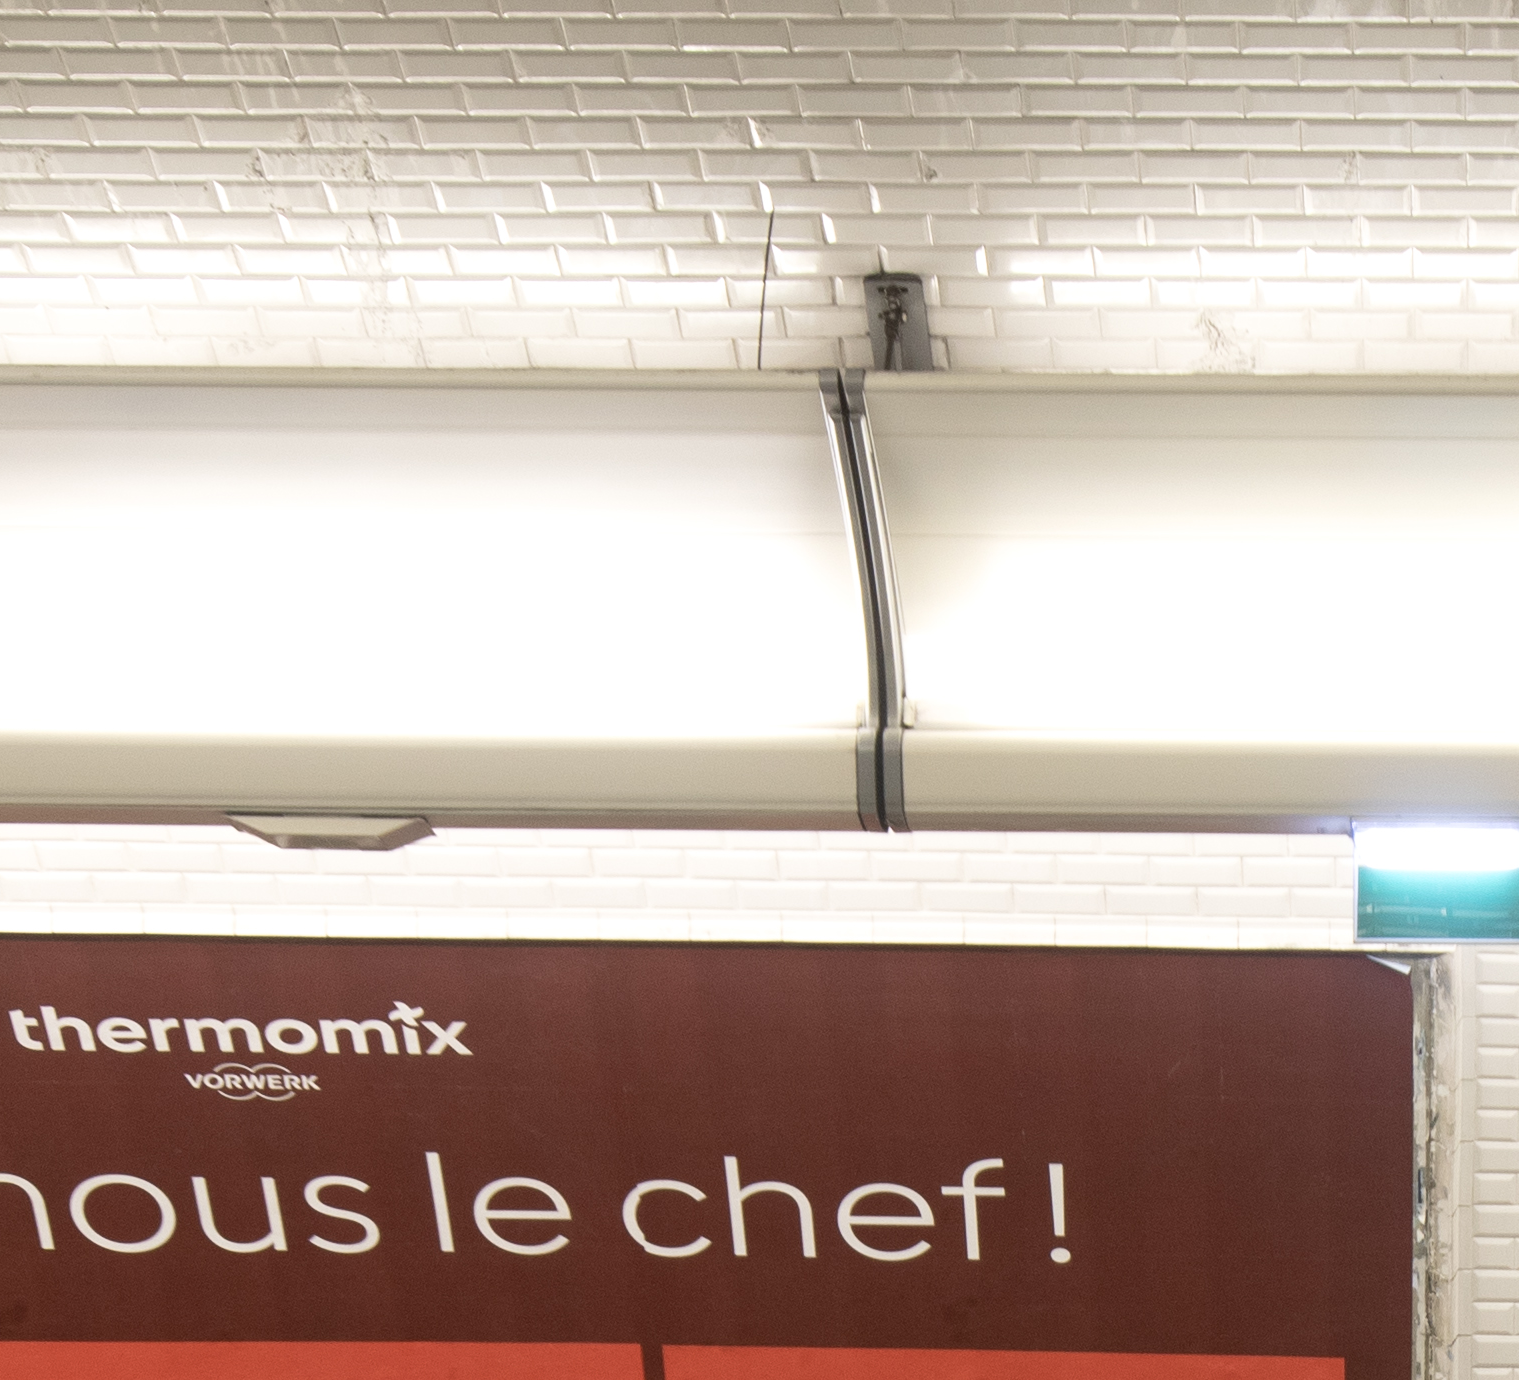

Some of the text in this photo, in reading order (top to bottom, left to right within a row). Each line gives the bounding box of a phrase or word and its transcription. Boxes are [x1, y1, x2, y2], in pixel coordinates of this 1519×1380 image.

[8, 1000, 473, 1056] thermomix
[184, 1072, 321, 1091] VORWERK
[425, 1152, 572, 1255] le
[623, 1155, 1006, 1261] chef
